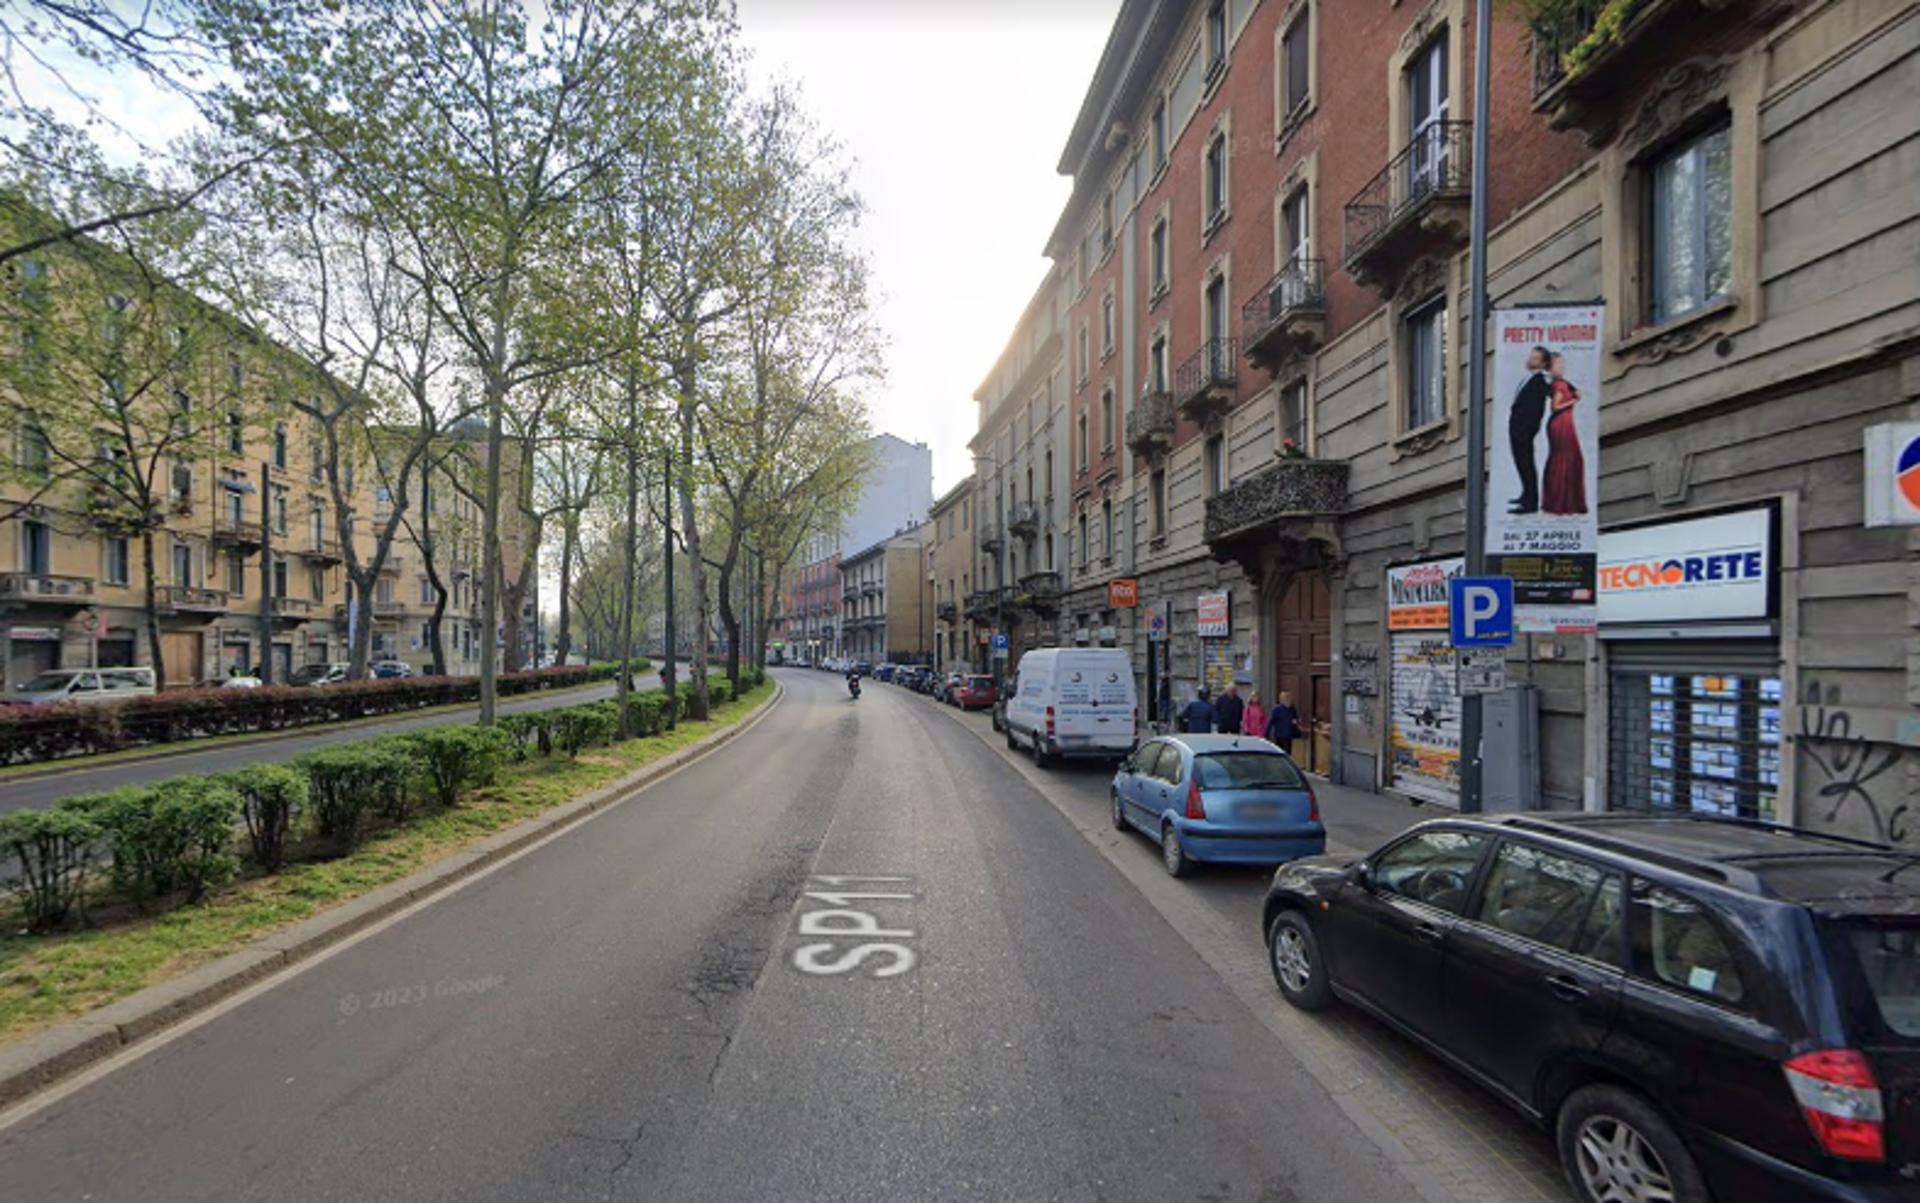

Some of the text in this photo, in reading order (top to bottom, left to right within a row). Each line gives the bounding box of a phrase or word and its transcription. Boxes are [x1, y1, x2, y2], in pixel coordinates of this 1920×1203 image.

[1504, 327, 1544, 343] PRETTY
[1525, 532, 1539, 541] 27
[1543, 531, 1581, 541] APRILE
[1529, 541, 1581, 551] MAGGIO
[1599, 551, 1762, 590] TECNORETE
[1464, 586, 1500, 638] P
[997, 635, 1006, 645] P
[794, 874, 916, 977] SP11
